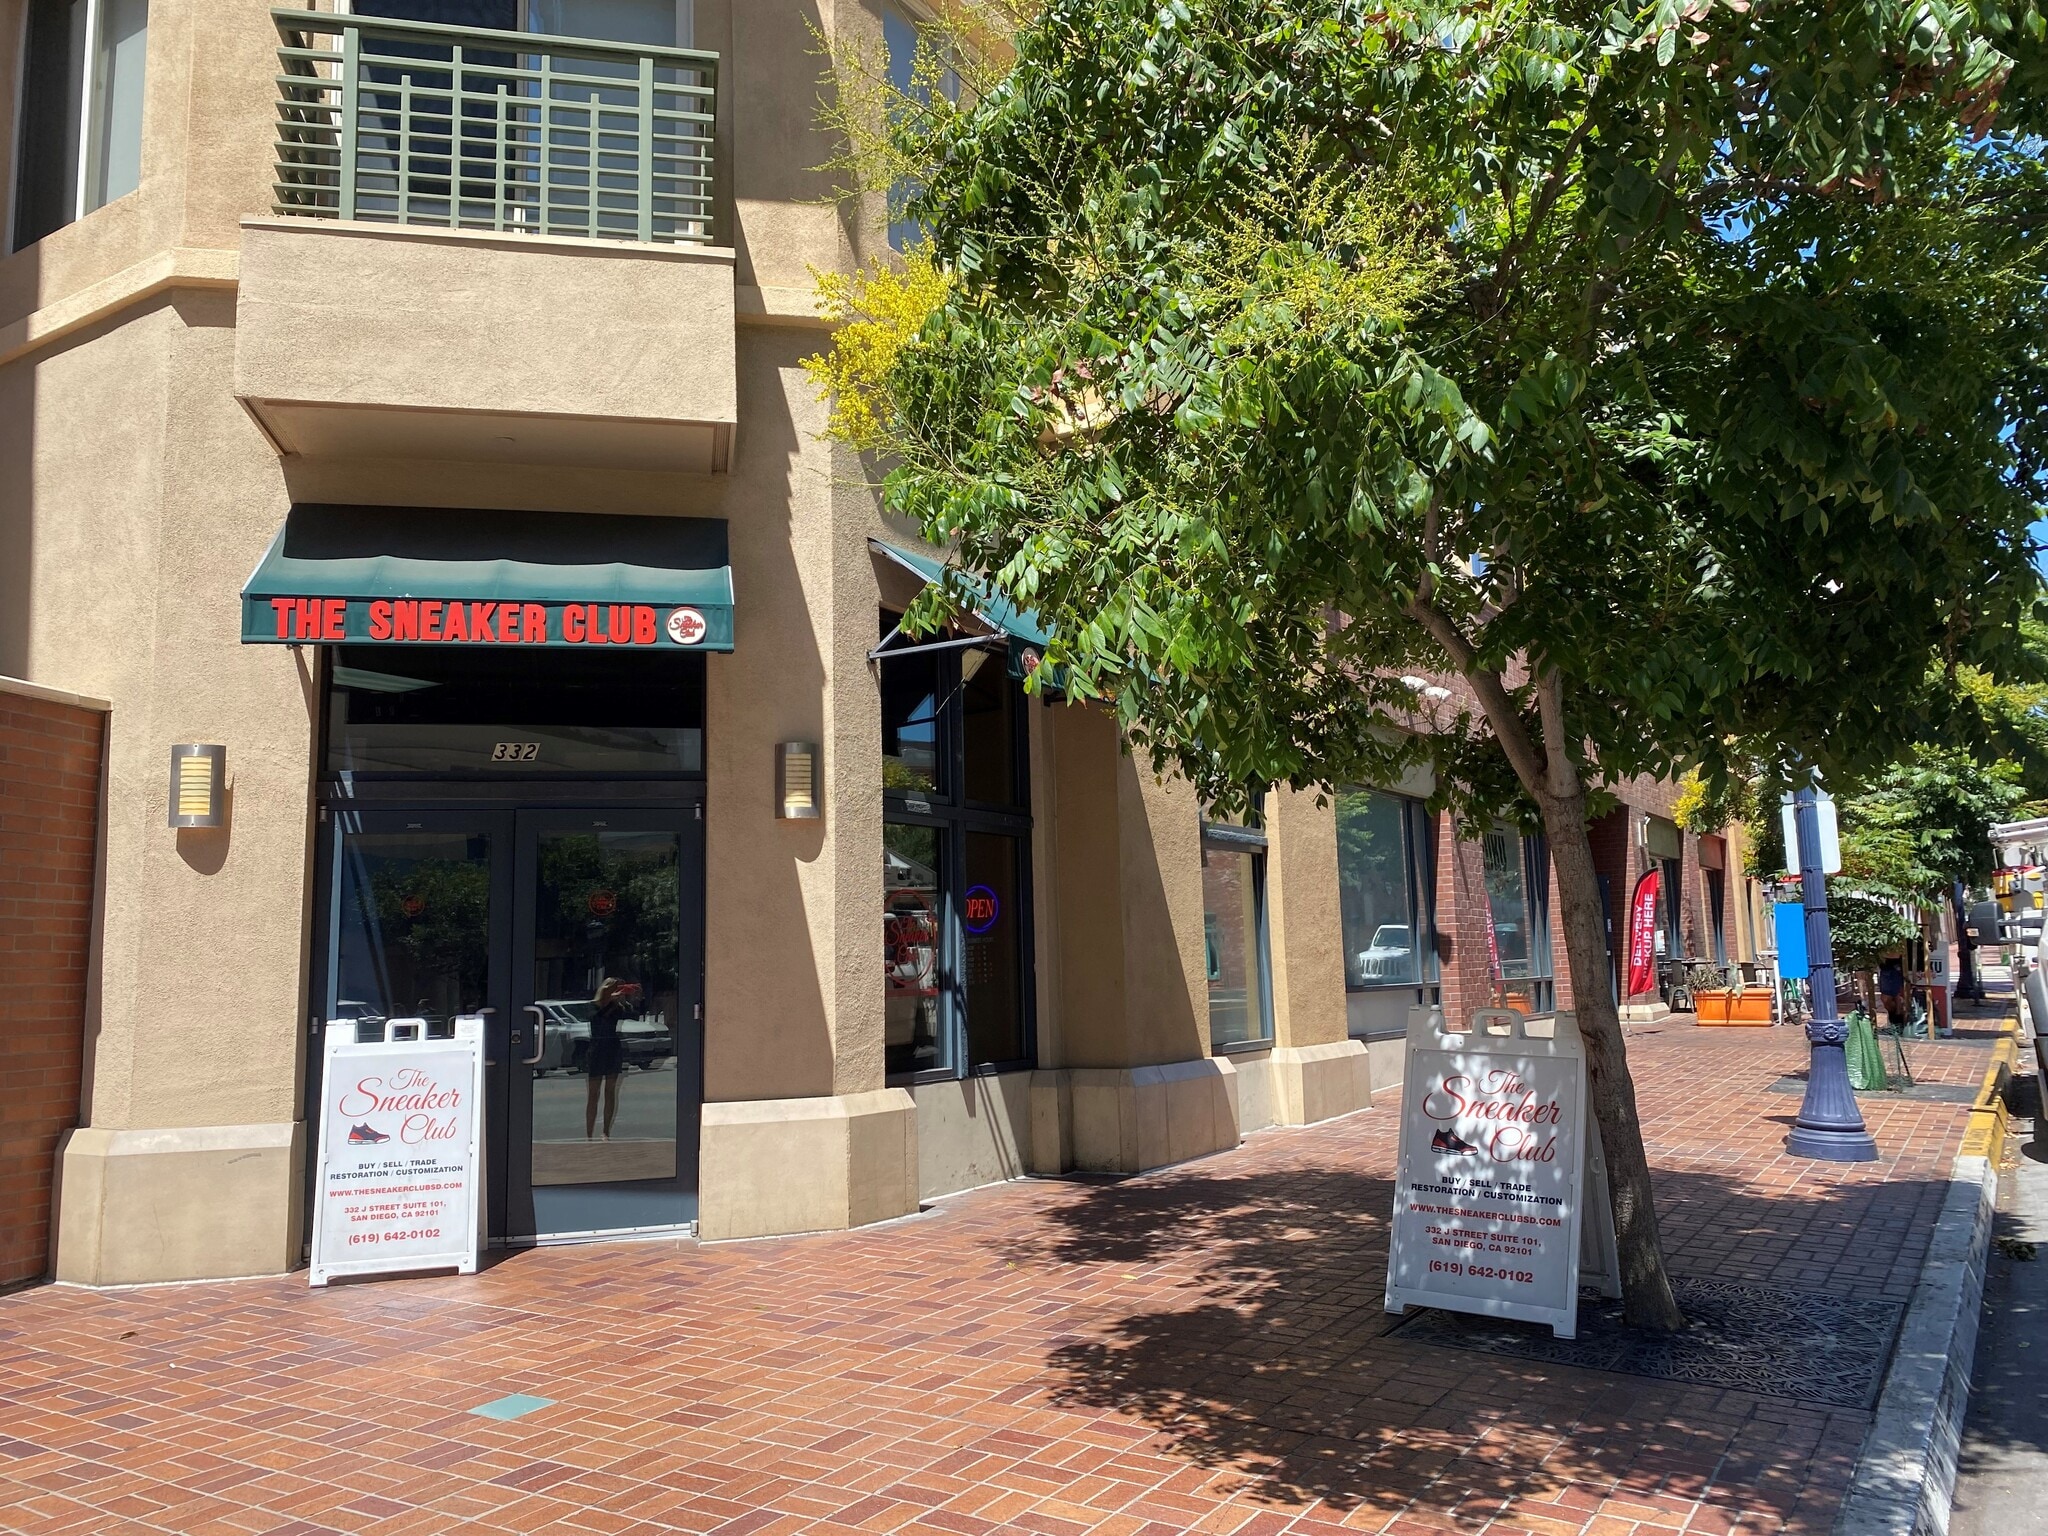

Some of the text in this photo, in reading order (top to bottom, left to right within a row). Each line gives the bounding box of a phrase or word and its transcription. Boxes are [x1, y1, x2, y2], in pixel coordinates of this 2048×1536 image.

[271, 598, 657, 645] THE SNEAKER CLUB
[494, 743, 537, 760] 332
[1643, 893, 1654, 927] HERE
[389, 1068, 430, 1090] The
[1478, 1069, 1525, 1095] The
[339, 1077, 461, 1118] Sneaker
[1422, 1075, 1562, 1125] Sneaker
[400, 1113, 457, 1145] Club
[1489, 1124, 1556, 1163] Club
[330, 1170, 389, 1180] RESTORATION
[395, 1165, 463, 1176] CUSTOMIZATION
[358, 1162, 376, 1170] BUY
[383, 1160, 403, 1168] SELL
[410, 1158, 437, 1166] TRADE
[329, 1182, 463, 1197] WWW.THESNEAKERCLUBSD.COM
[1411, 1183, 1475, 1197] RESTORATION
[1483, 1191, 1563, 1206] CUSTOMIZATION
[1441, 1176, 1461, 1185] BUY
[1469, 1179, 1492, 1188] SELL
[1500, 1182, 1532, 1192] TRADE
[344, 1206, 359, 1214] 332
[369, 1203, 401, 1212] STREET
[402, 1201, 427, 1209] SUITE
[350, 1214, 368, 1222] SAN
[370, 1212, 399, 1220] DIEGO,
[414, 1209, 439, 1217] 92101
[1410, 1203, 1561, 1227] WWW.THESNEAKERCLUBSD.COM
[348, 1228, 440, 1245] (619) 642-0102
[1425, 1226, 1542, 1247] 332 J STREET SUITE 101,
[1432, 1237, 1532, 1256] SAN DIEGO, CA 92101
[1429, 1259, 1533, 1283] (619) 642-0102
